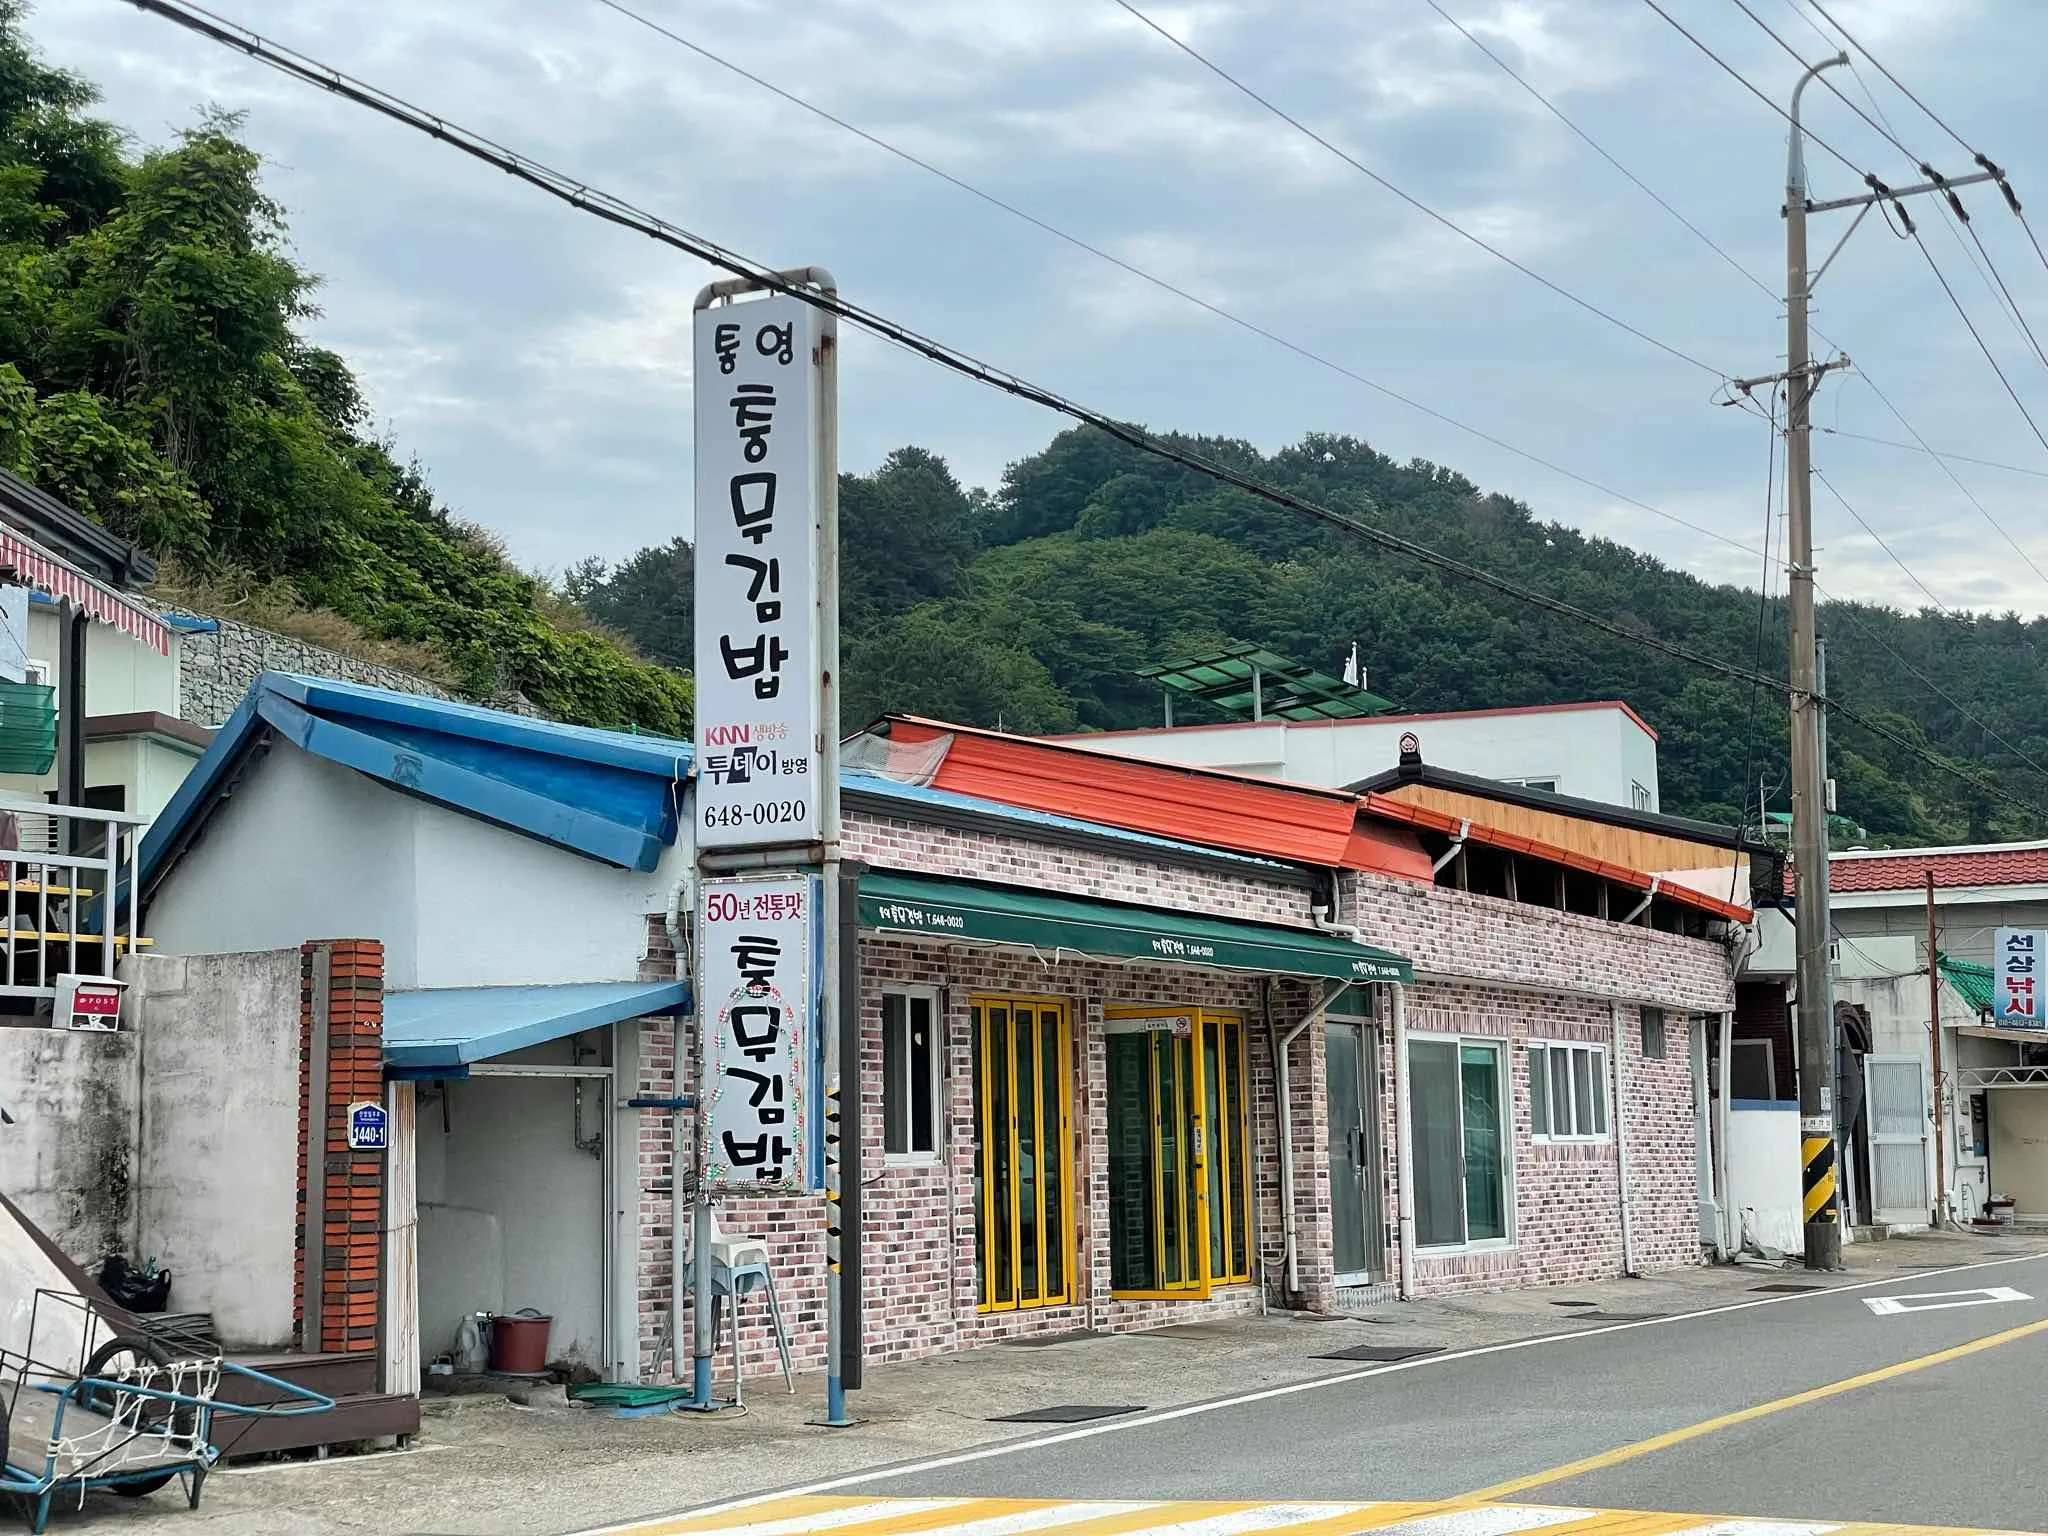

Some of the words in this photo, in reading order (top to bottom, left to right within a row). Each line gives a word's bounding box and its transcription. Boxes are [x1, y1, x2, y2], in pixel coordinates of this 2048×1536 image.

[715, 321, 794, 375] 통영
[721, 384, 789, 699] 충무김밥
[704, 723, 750, 747] KNN
[754, 723, 790, 741] 생방송
[704, 748, 777, 785] 투데이
[781, 757, 808, 775] 방영
[704, 800, 806, 828] 648-0020
[707, 893, 750, 922] 50년
[753, 892, 801, 921] 전통맛
[2005, 934, 2036, 1015] 선상낚시
[722, 935, 792, 1184] 충무김밥
[354, 1126, 384, 1143] 1440-1
